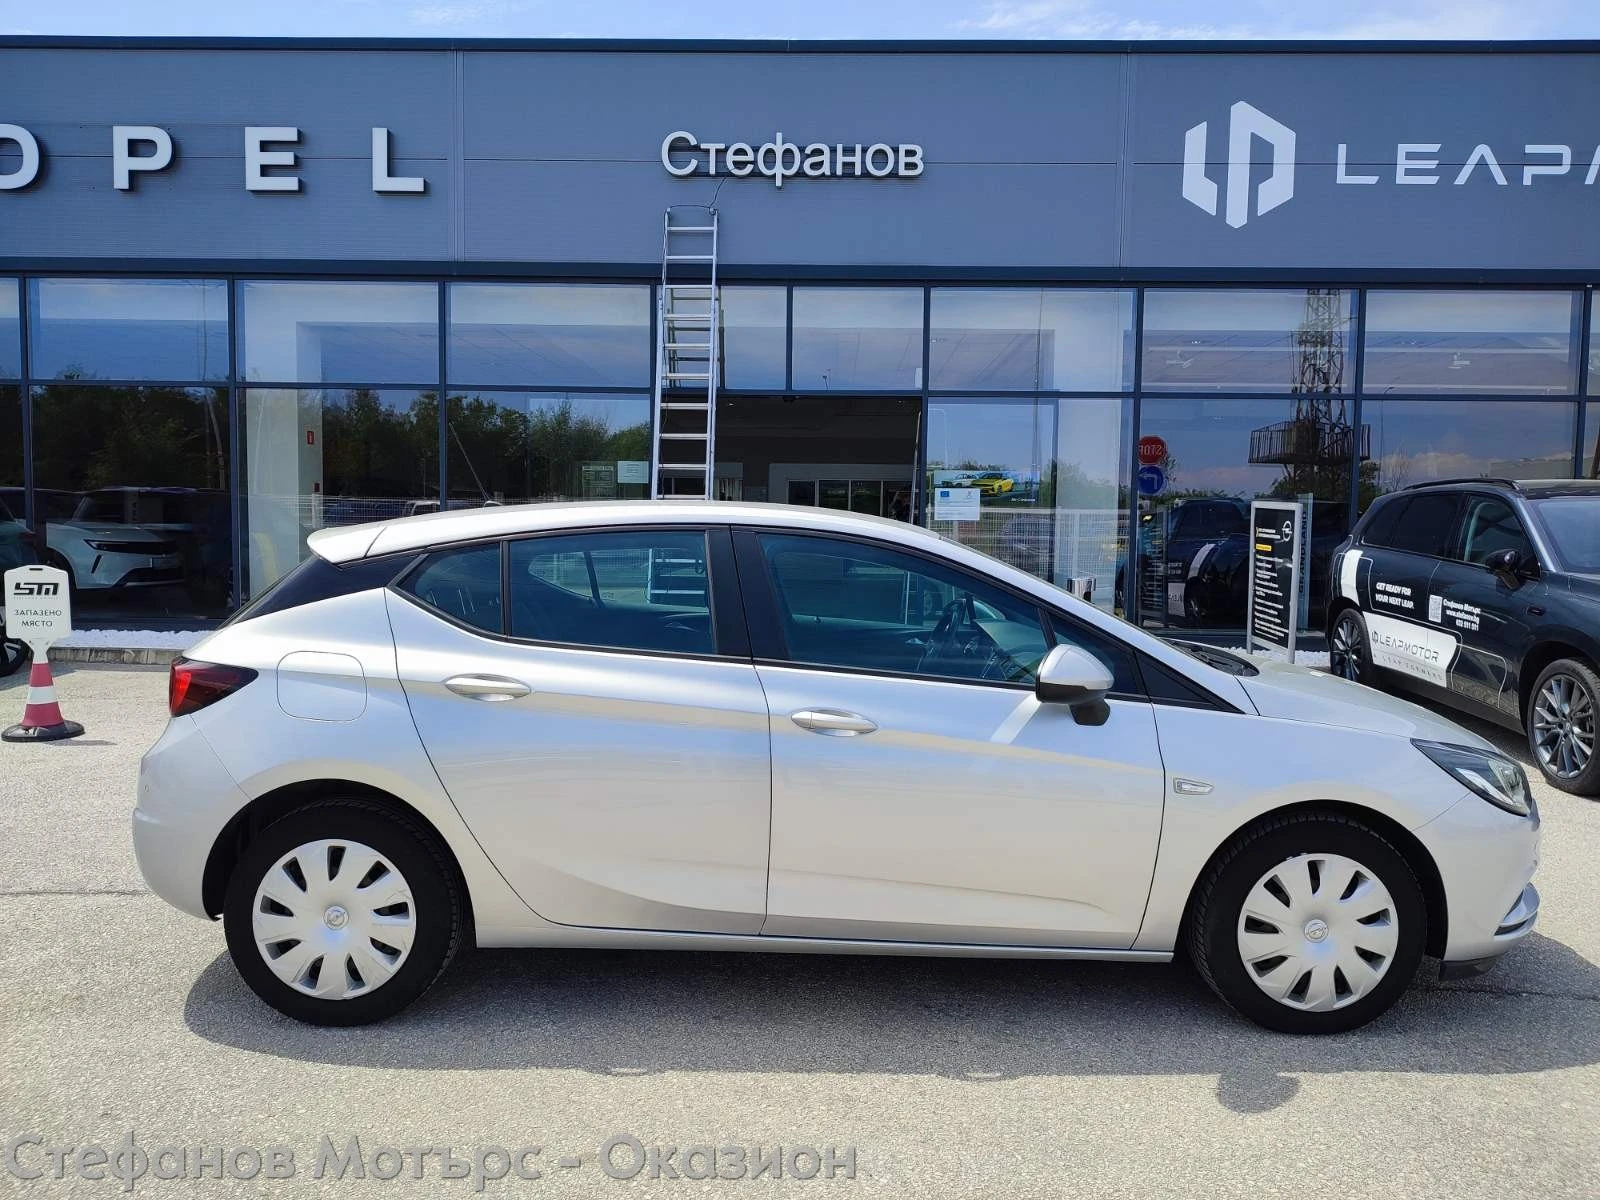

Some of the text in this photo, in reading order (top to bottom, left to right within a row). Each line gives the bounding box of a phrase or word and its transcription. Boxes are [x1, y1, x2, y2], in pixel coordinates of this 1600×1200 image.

[661, 131, 925, 187] Стефанов
[1375, 582, 1412, 596] GET READY FOR
[1375, 593, 1389, 603] YOUR
[1388, 595, 1402, 606] NEXT
[1380, 634, 1439, 662] LEAPMOTOR
